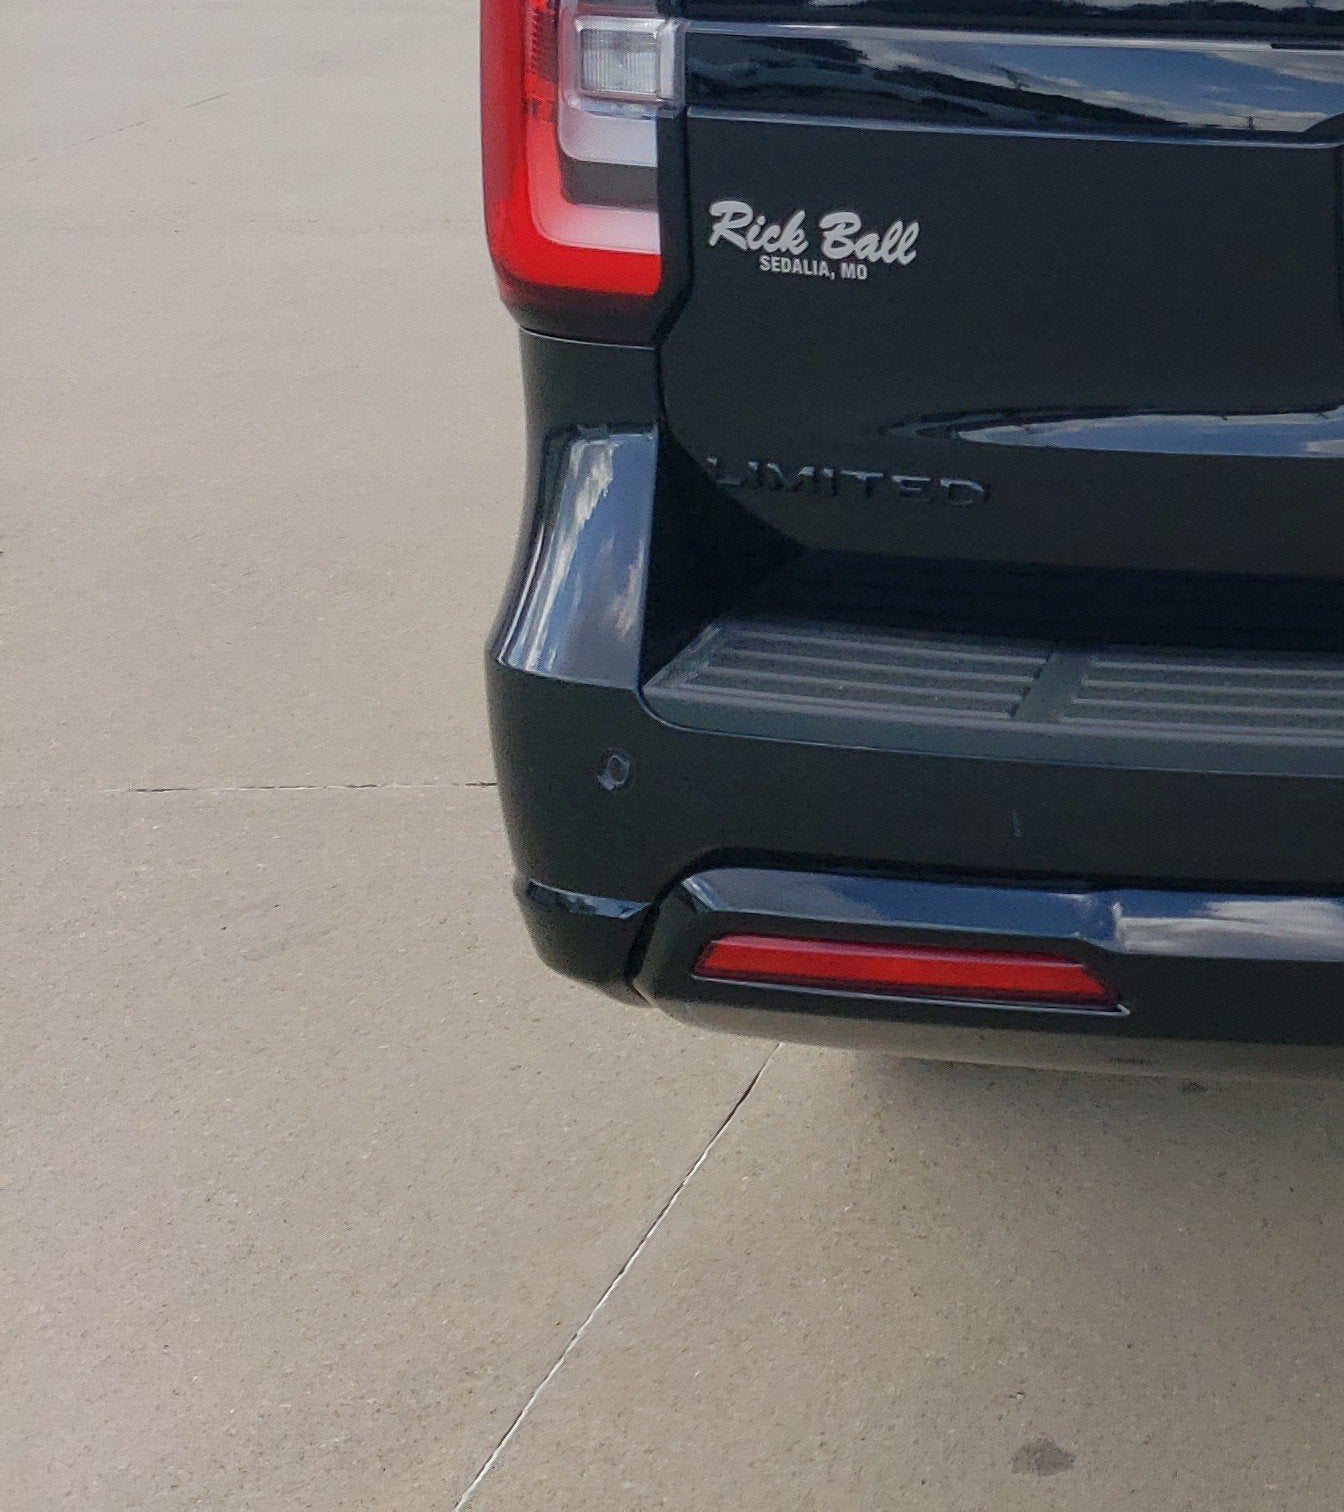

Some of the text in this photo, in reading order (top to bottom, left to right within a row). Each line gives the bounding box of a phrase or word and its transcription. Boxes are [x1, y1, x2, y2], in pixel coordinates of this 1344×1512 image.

[709, 200, 920, 265] Rick Ball
[759, 255, 868, 280] SEDALIA, MO
[706, 455, 990, 506] LIMITED
